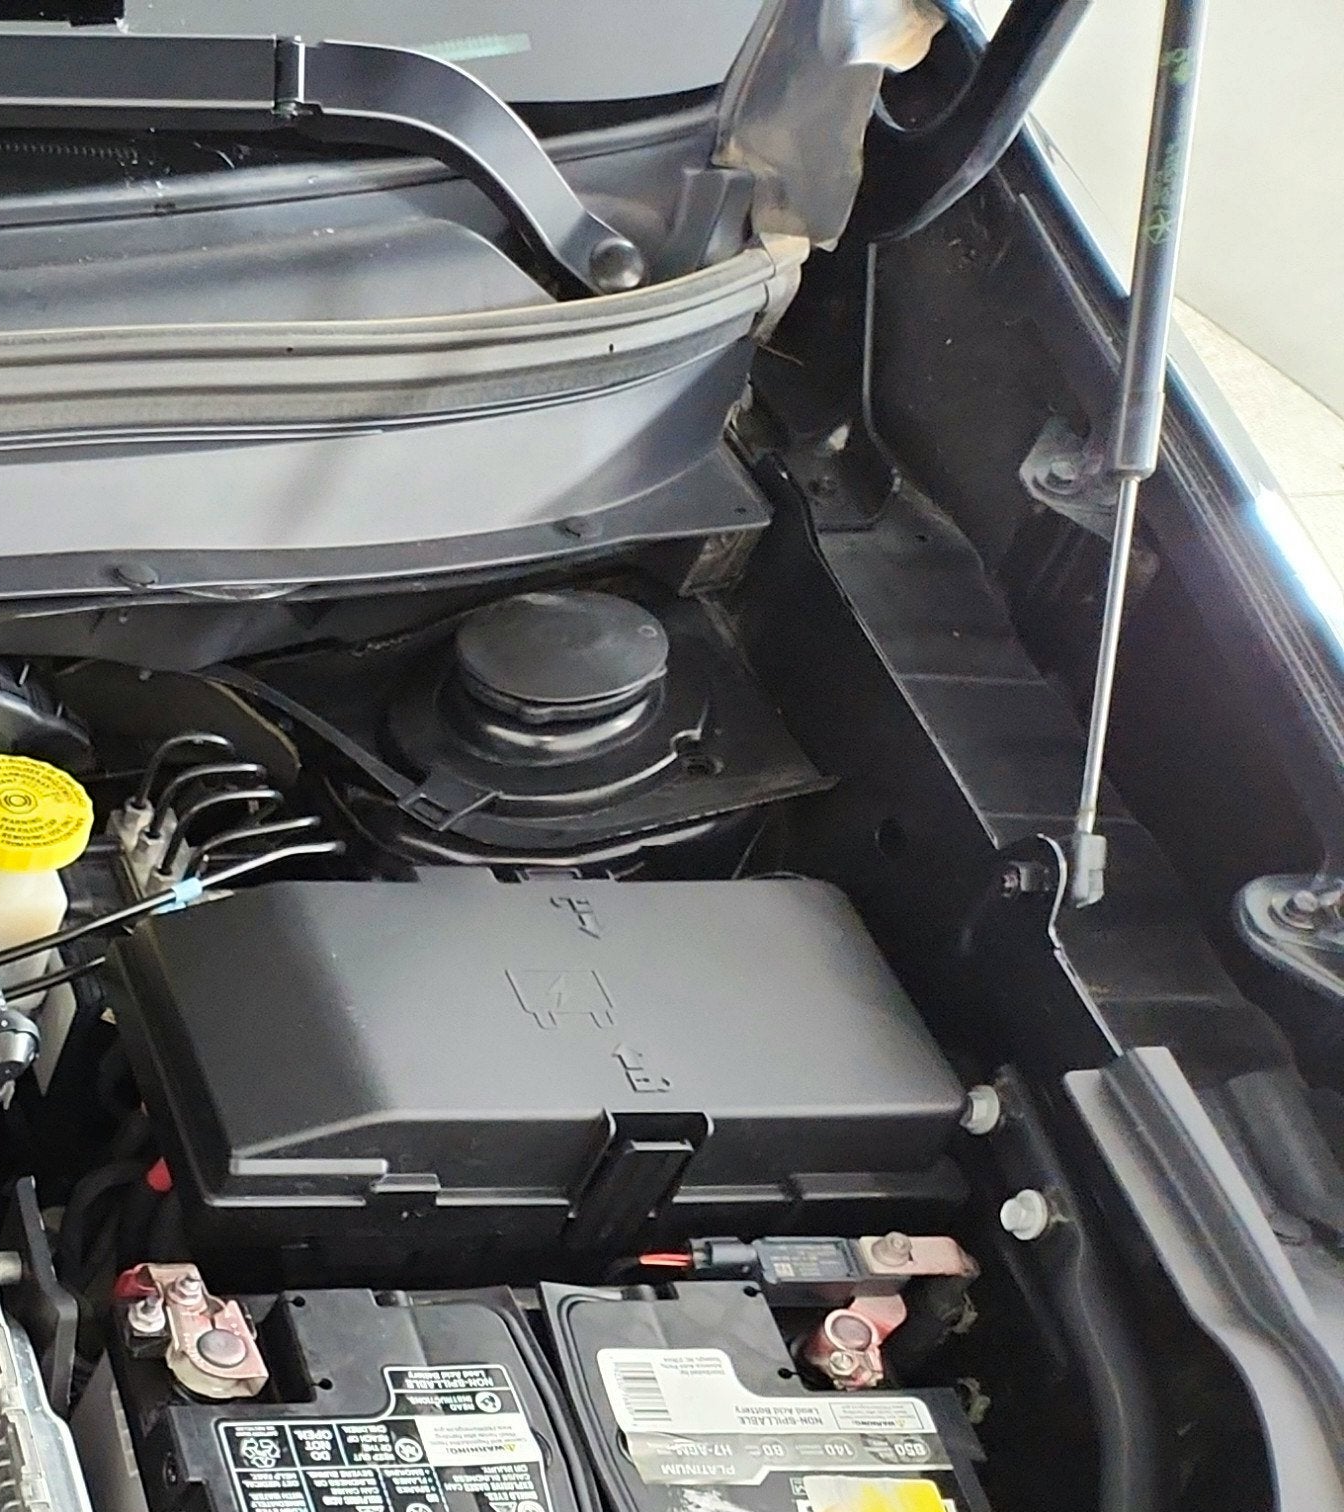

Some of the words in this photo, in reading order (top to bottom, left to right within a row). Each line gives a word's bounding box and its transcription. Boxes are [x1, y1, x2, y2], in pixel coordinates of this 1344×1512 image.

[404, 1378, 495, 1389] NON-SPILLABLE
[734, 1405, 771, 1416] Battery
[737, 1415, 824, 1427] NON-SPILLABLE
[304, 1440, 332, 1451] NOT
[823, 1443, 855, 1457] 140
[310, 1450, 332, 1461] DO
[659, 1463, 736, 1477] PLATINUM
